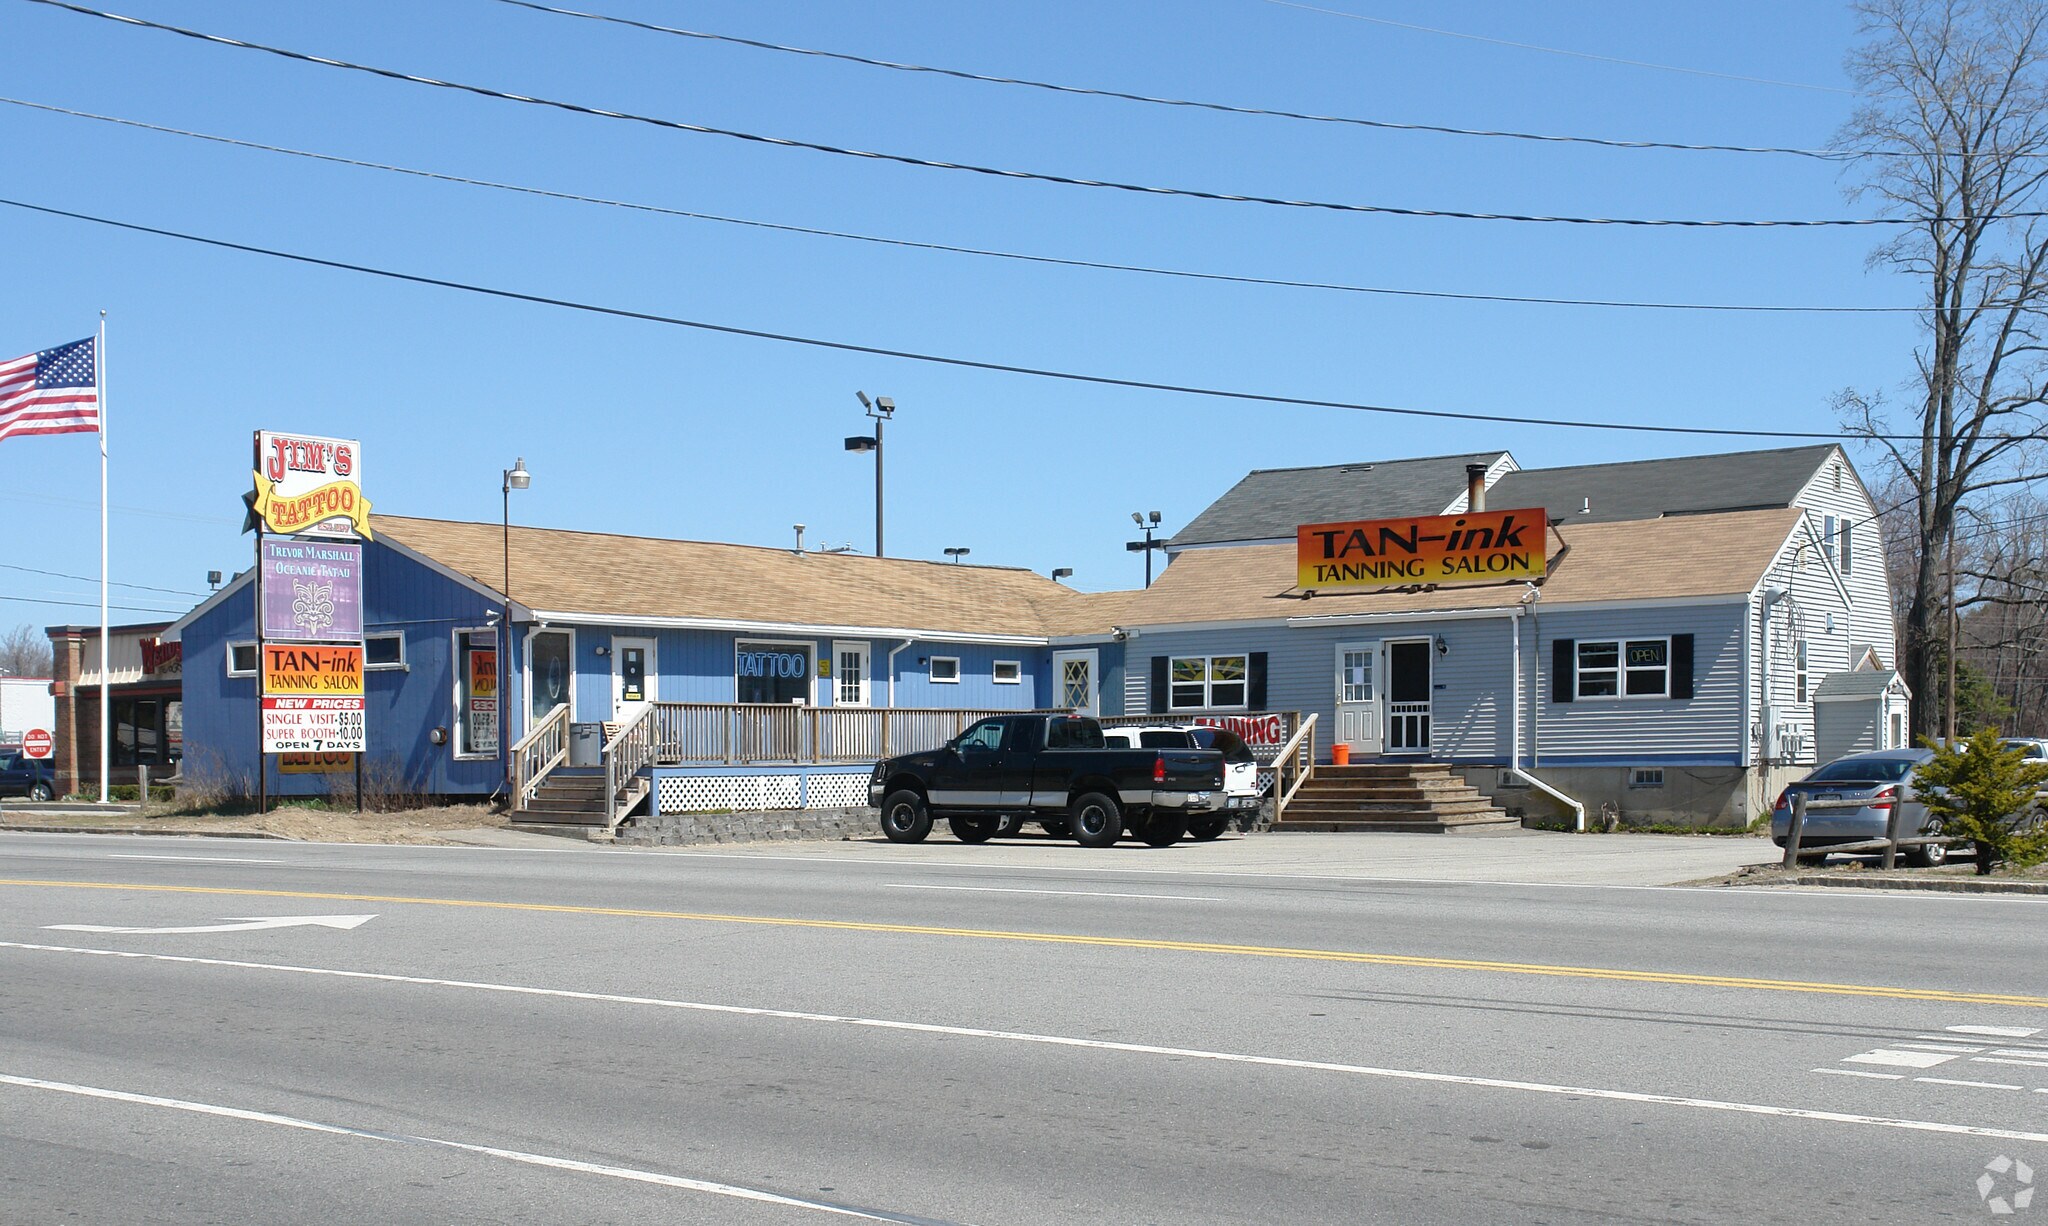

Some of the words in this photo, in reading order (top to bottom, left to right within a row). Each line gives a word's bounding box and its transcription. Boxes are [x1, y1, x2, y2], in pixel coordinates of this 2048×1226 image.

[268, 437, 352, 482] JIM'S
[271, 487, 354, 527] TATTOO
[1312, 516, 1528, 559] TAN-ink
[270, 544, 305, 558] TREVOR
[306, 546, 354, 561] MARSHALL
[276, 562, 316, 576] OCEANIC
[320, 564, 350, 577] TATAU
[1313, 558, 1424, 582] TANNING
[1441, 552, 1529, 575] SALON
[269, 650, 357, 672] TAN-ink
[1631, 649, 1659, 662] OPEN
[737, 652, 805, 678] TATTOO
[270, 674, 317, 689] TANNING
[323, 675, 358, 689] SALON
[275, 699, 308, 709] NEW
[312, 699, 361, 709] PRICES
[266, 714, 302, 725] SINGLE
[339, 712, 362, 726] $5.00
[266, 728, 295, 740] SUPER
[276, 741, 309, 749] OPEN
[313, 740, 323, 751] 7
[327, 741, 360, 749] DAYS
